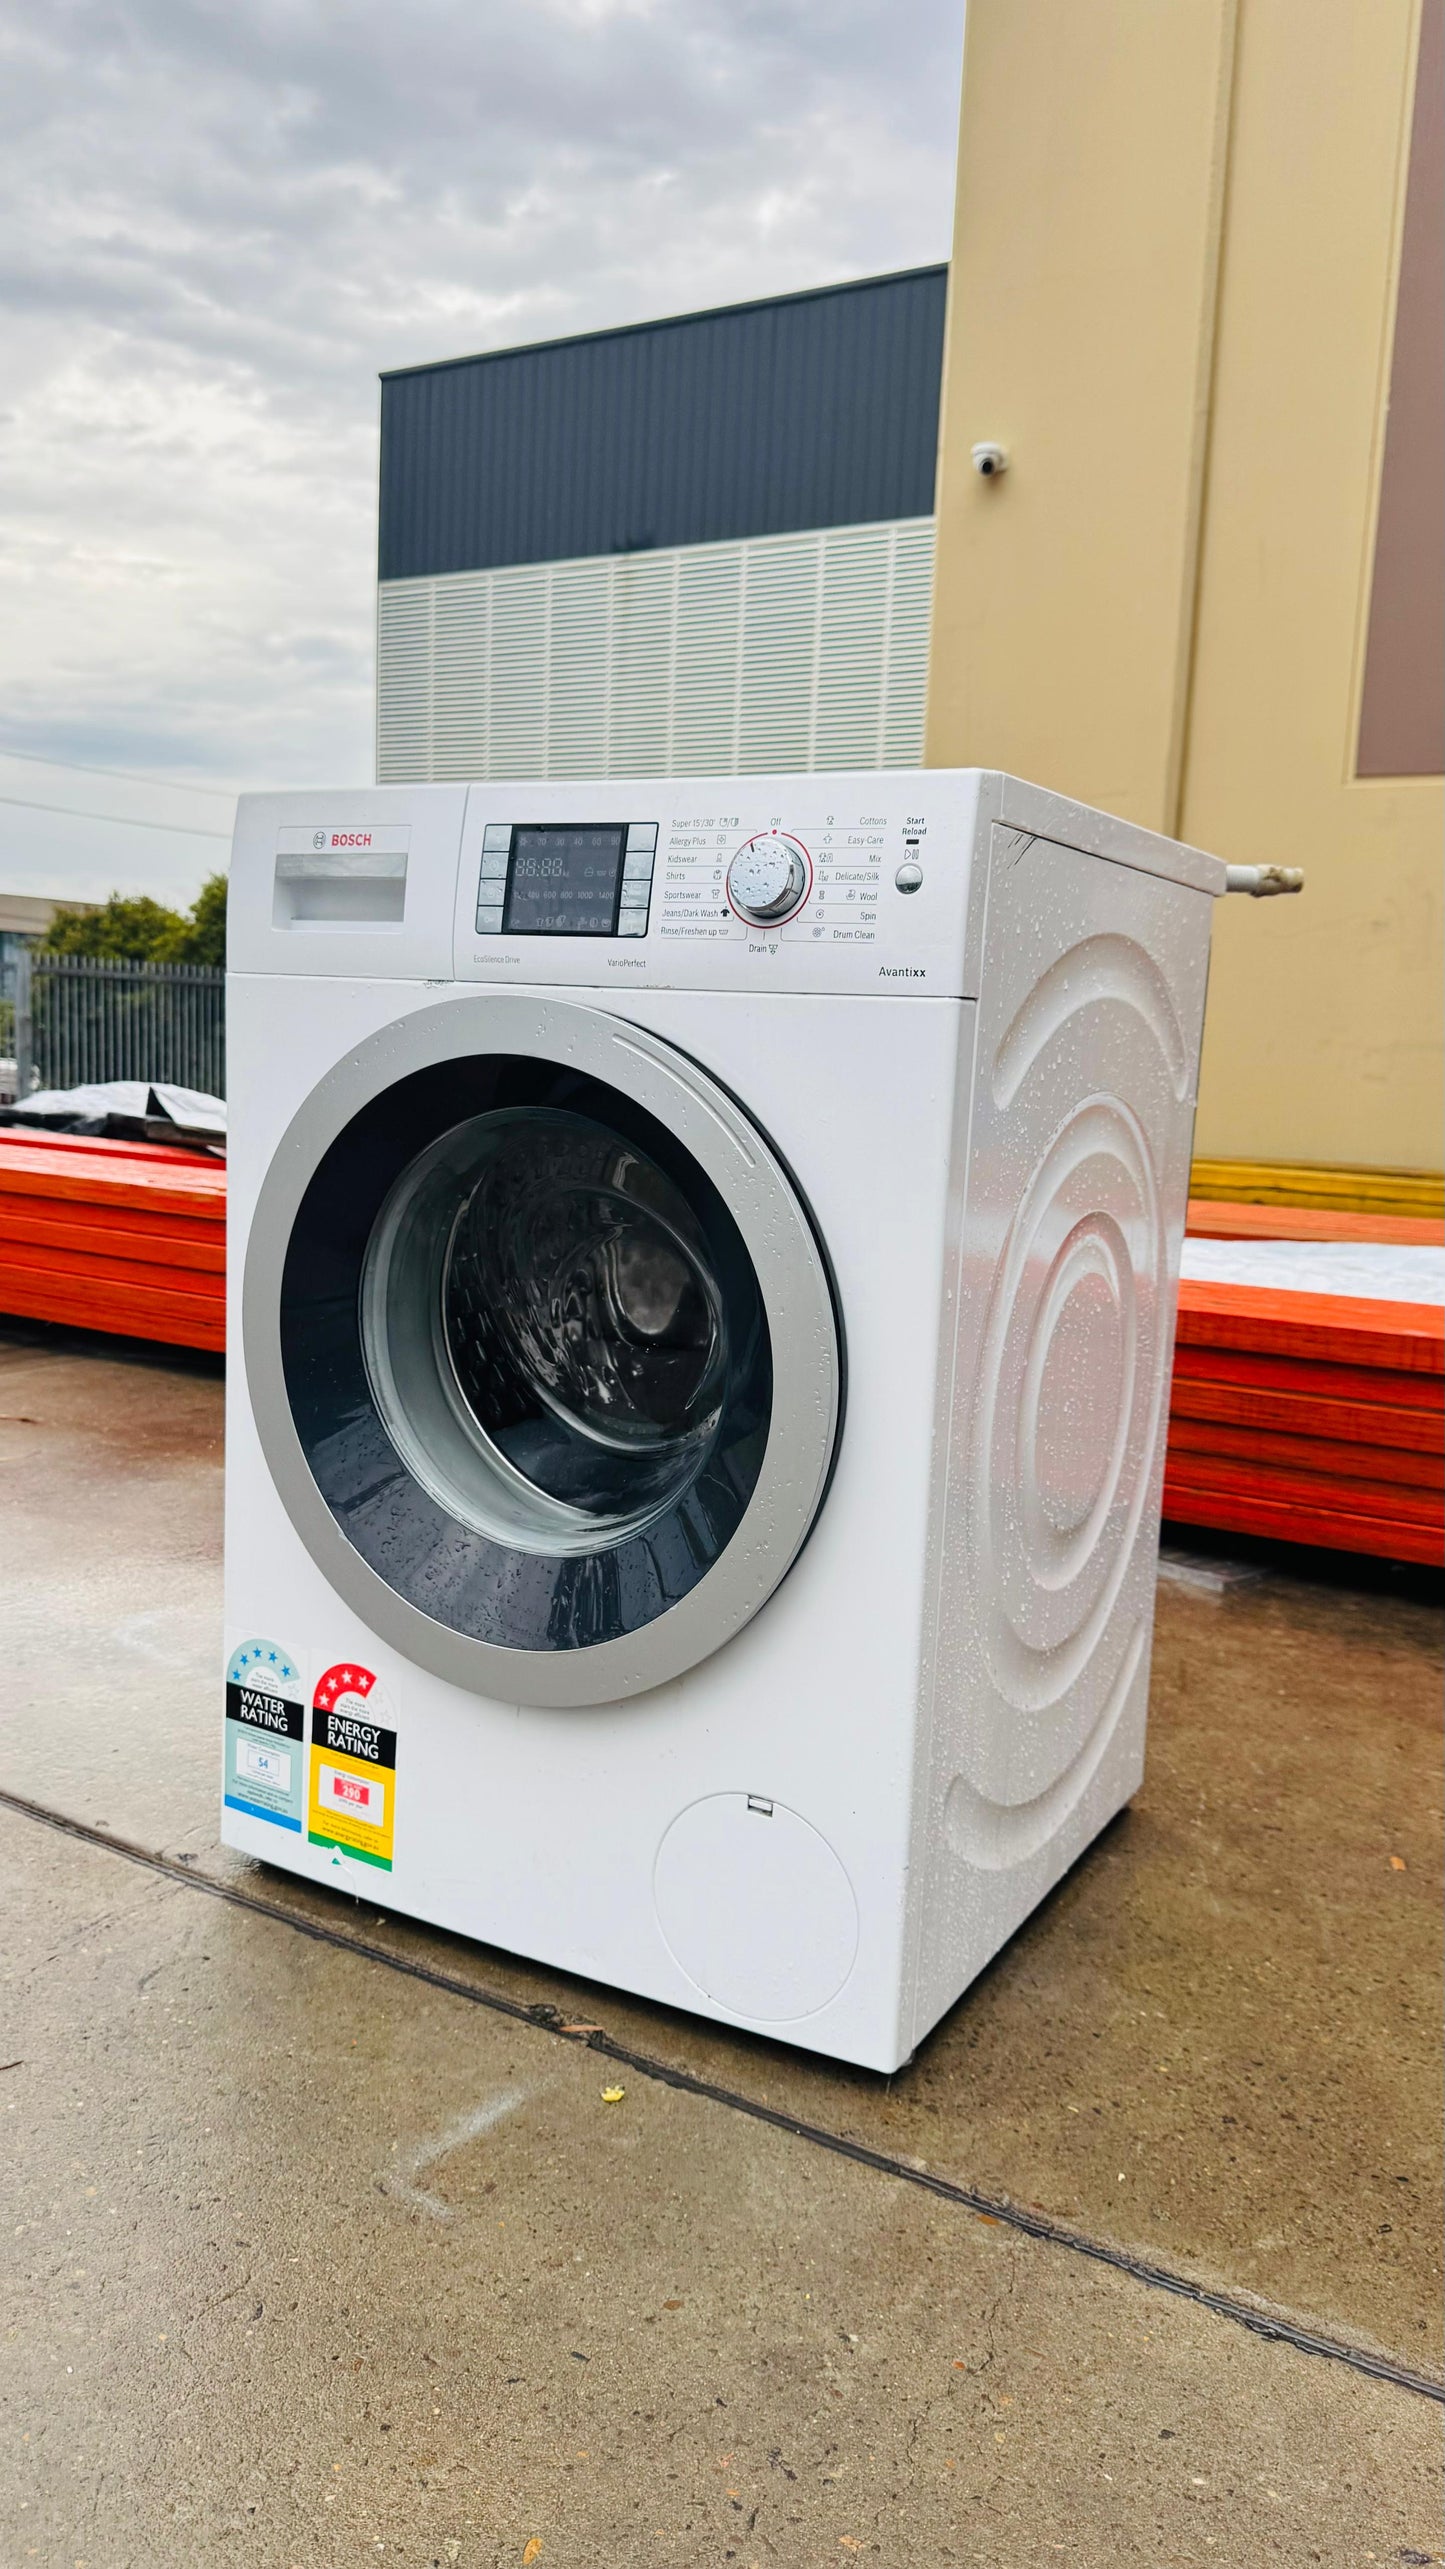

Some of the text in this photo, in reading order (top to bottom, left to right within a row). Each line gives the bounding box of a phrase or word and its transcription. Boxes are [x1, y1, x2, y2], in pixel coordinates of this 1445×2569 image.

[671, 819, 692, 829] Super
[770, 817, 782, 826] Off
[859, 816, 887, 825] Cottons
[906, 816, 925, 825] Start
[902, 827, 927, 836] Reload
[331, 833, 372, 847] BOSCH
[669, 837, 706, 847] Allergy Plus
[667, 854, 698, 864] Kidswear
[869, 854, 882, 863] Mix
[665, 871, 686, 880] Shirts
[835, 871, 880, 882] Delicate/Silk
[664, 890, 702, 900] Sportswear
[860, 892, 878, 901] Wool
[661, 909, 719, 918] Jeans/Dark Wash
[859, 911, 877, 922] Spin
[660, 926, 718, 937] Rinse/Freshen up
[833, 929, 875, 940] Drum Clean
[748, 943, 767, 954] Drain
[473, 954, 521, 965] EcoSilence Drive
[607, 958, 647, 969] VarioPerfect
[878, 966, 926, 978] Avantixx
[240, 1689, 286, 1716] WATER
[240, 1704, 289, 1732] RATING
[327, 1715, 381, 1743] ENERGY
[327, 1730, 379, 1760] RATING
[258, 1757, 269, 1769] 54
[342, 1785, 361, 1801] 290
